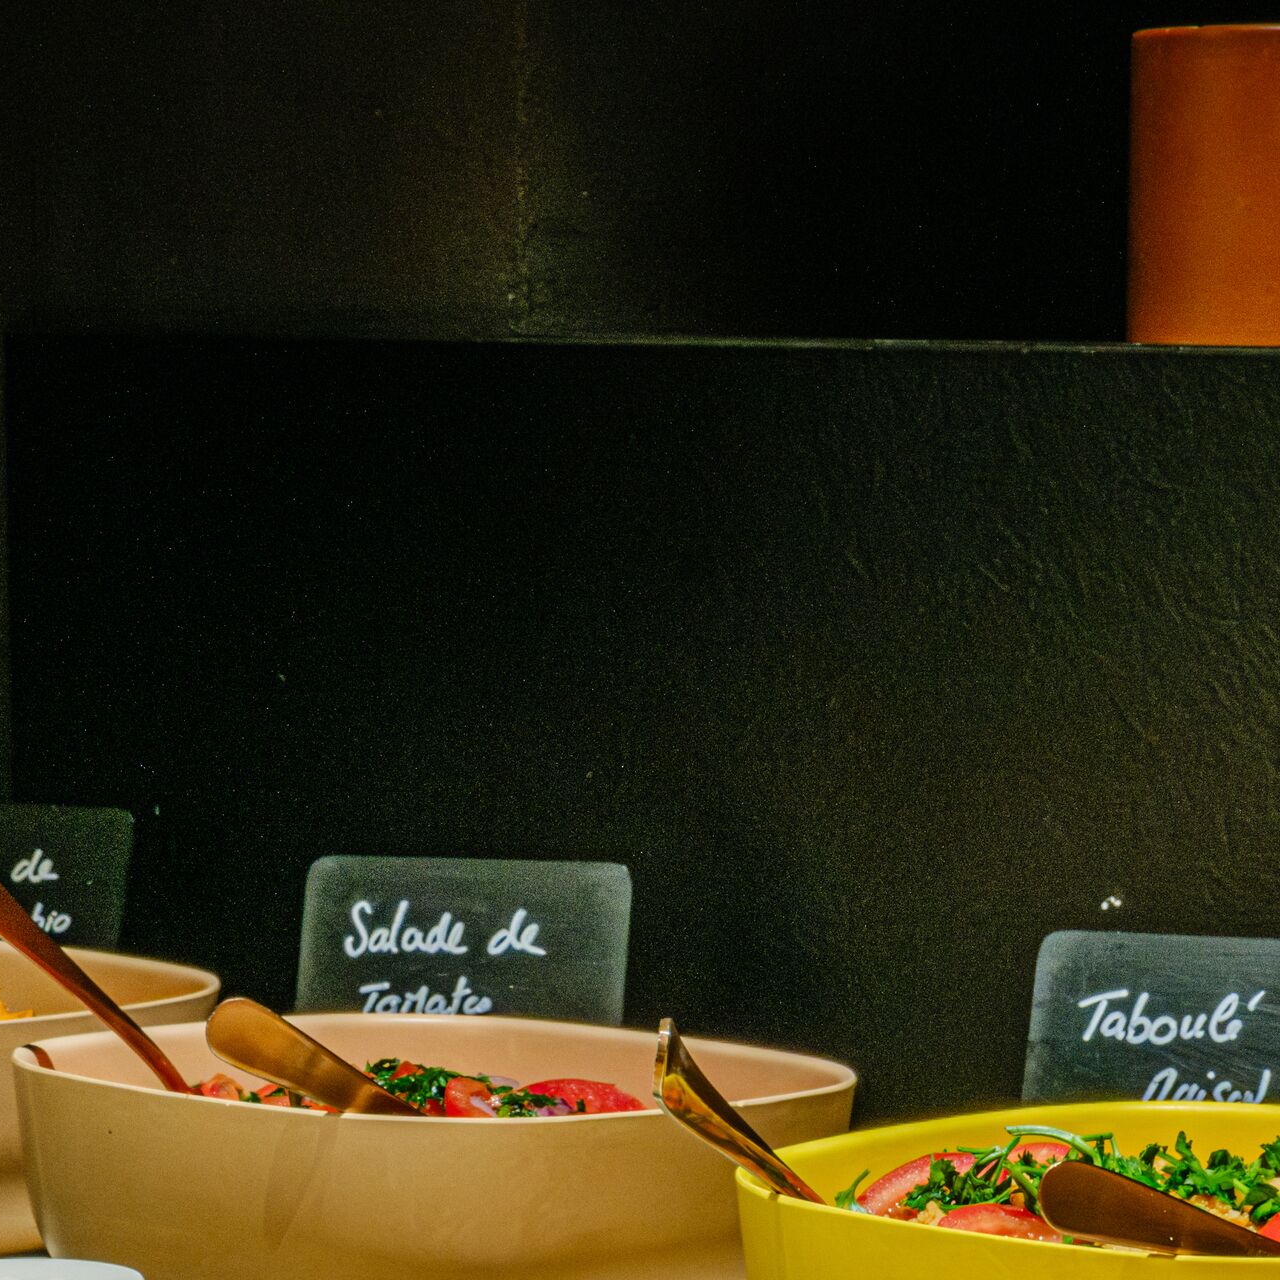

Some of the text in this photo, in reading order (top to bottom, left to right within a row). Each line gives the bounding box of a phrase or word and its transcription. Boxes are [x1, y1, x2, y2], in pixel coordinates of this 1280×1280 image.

[10, 848, 59, 883] de
[344, 899, 546, 958] Salade de
[1078, 989, 1266, 1046] Taboulé
